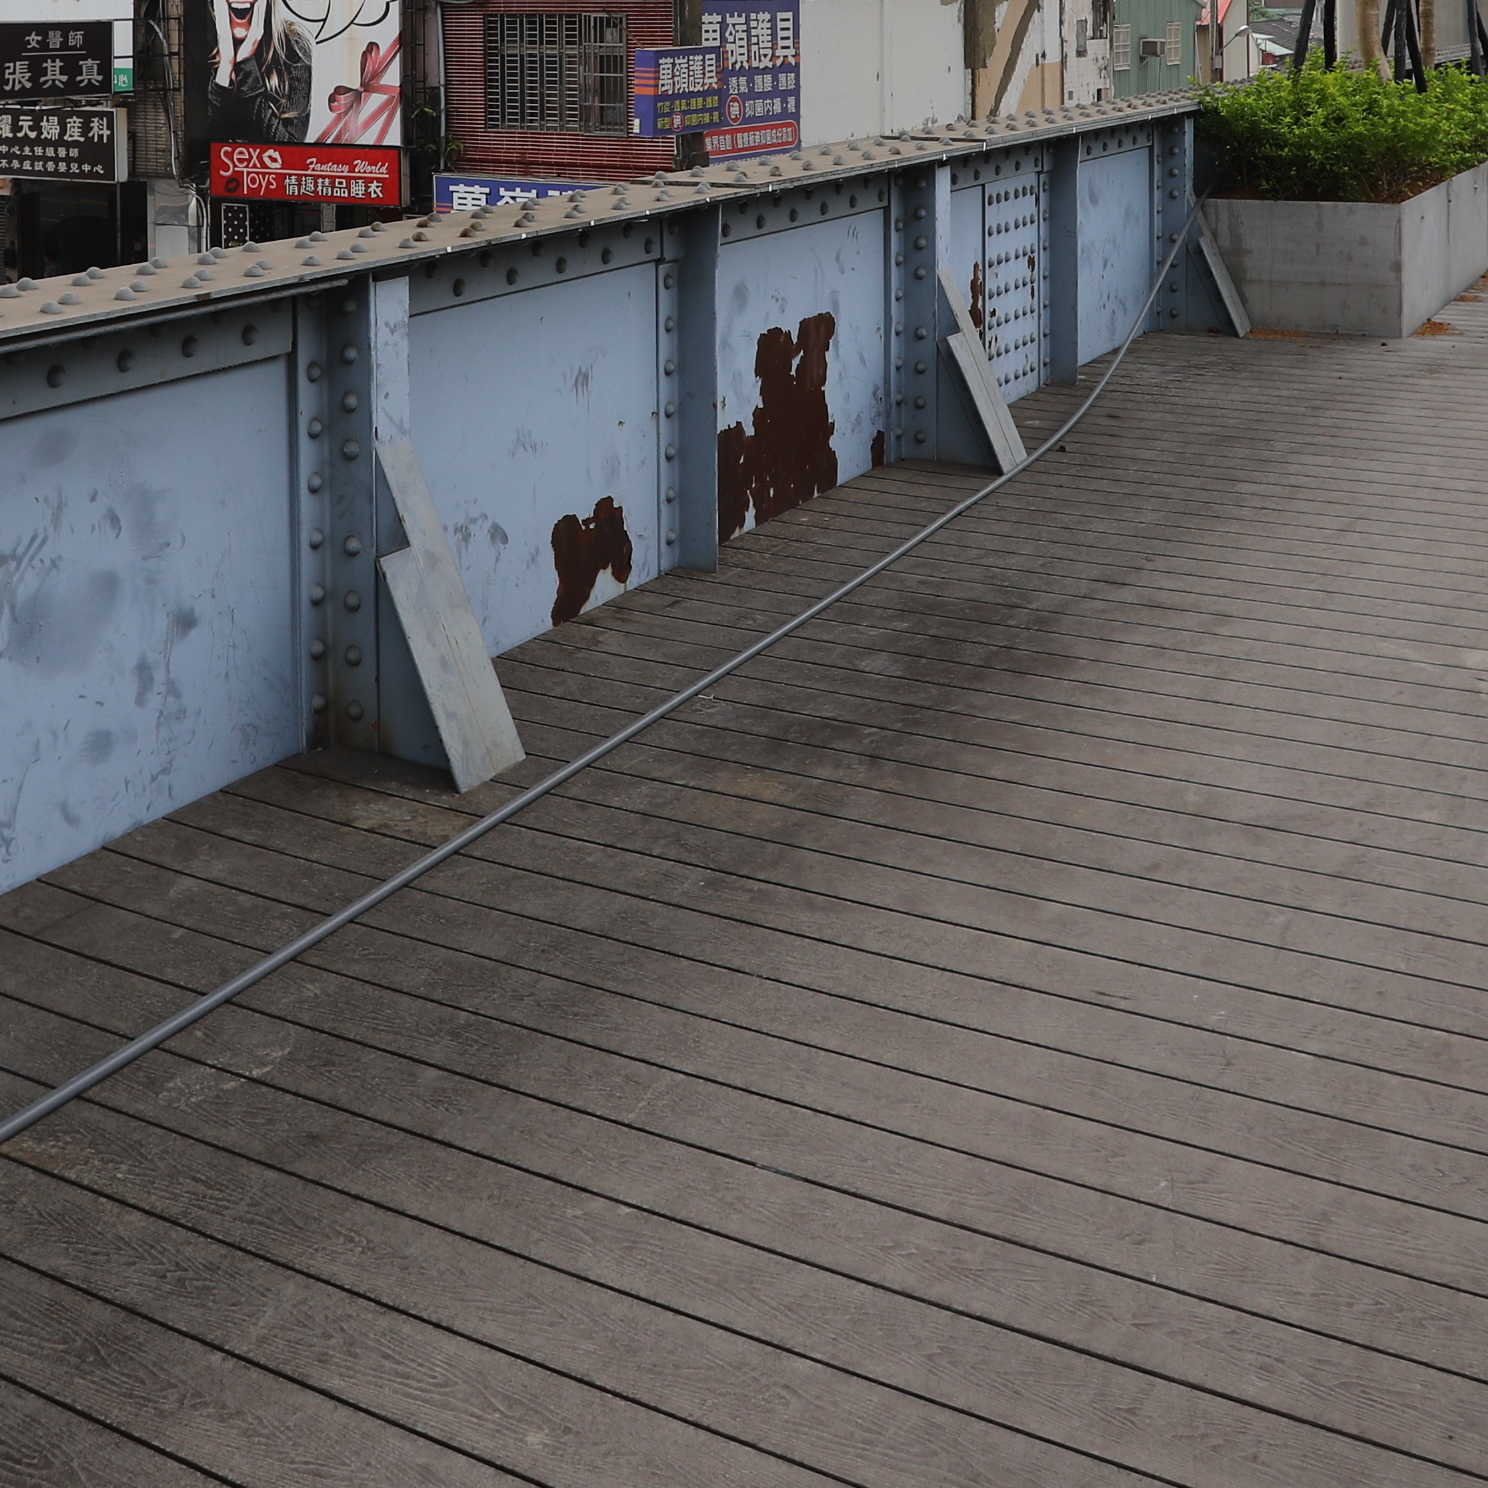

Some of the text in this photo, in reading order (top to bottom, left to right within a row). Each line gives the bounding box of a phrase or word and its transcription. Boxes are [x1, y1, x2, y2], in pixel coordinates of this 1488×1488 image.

[24, 30, 85, 49] 女醫師
[701, 11, 796, 71] 萬嶺護具
[3, 58, 104, 92] 張其真
[658, 53, 718, 95] 萬嶺護具
[0, 159, 105, 174] 不孕症試管嬰兒中心
[306, 158, 350, 173] Fantasy
[353, 159, 389, 174] World
[243, 169, 278, 196] Toys
[284, 175, 384, 199] 情趣精品睡衣
